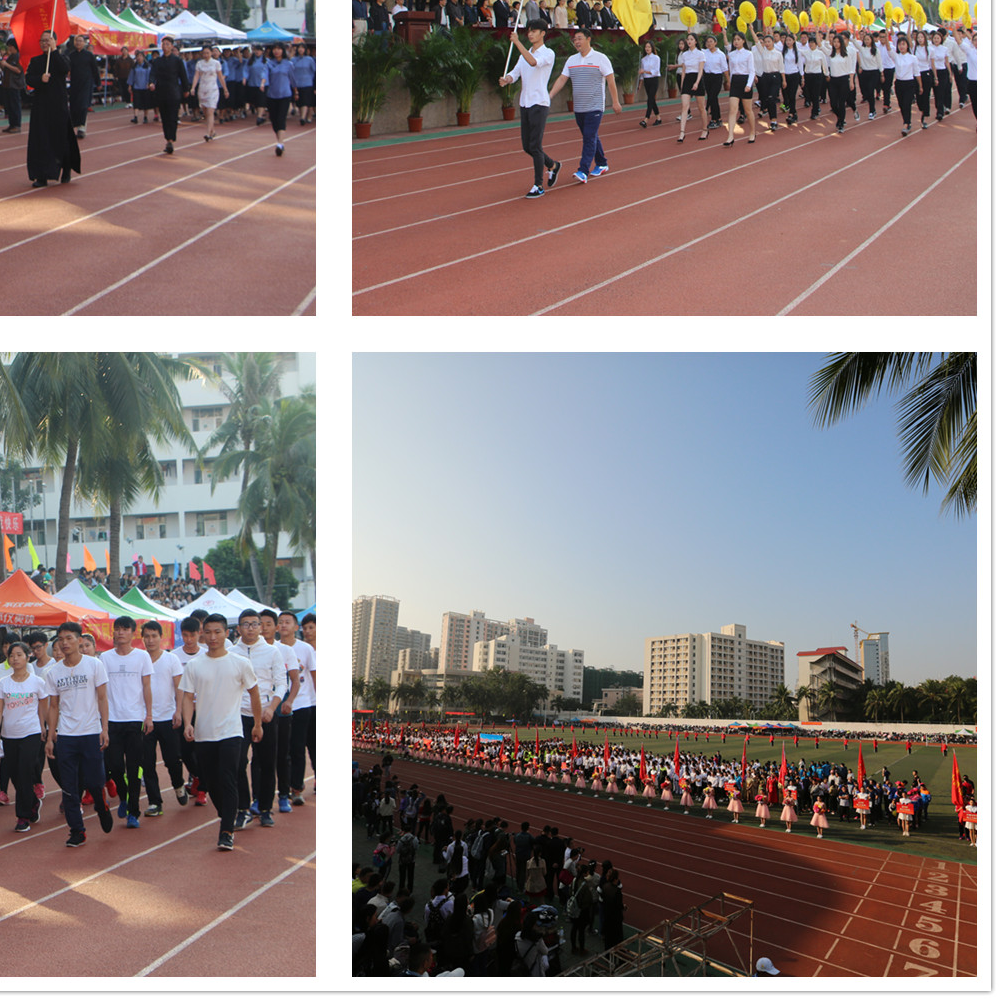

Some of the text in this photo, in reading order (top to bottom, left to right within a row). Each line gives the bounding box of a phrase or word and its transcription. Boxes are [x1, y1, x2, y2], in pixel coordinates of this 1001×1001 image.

[927, 871, 949, 883] 2
[924, 884, 949, 896] 3
[919, 900, 948, 914] 4
[915, 915, 943, 933] 5
[909, 938, 941, 959] 6
